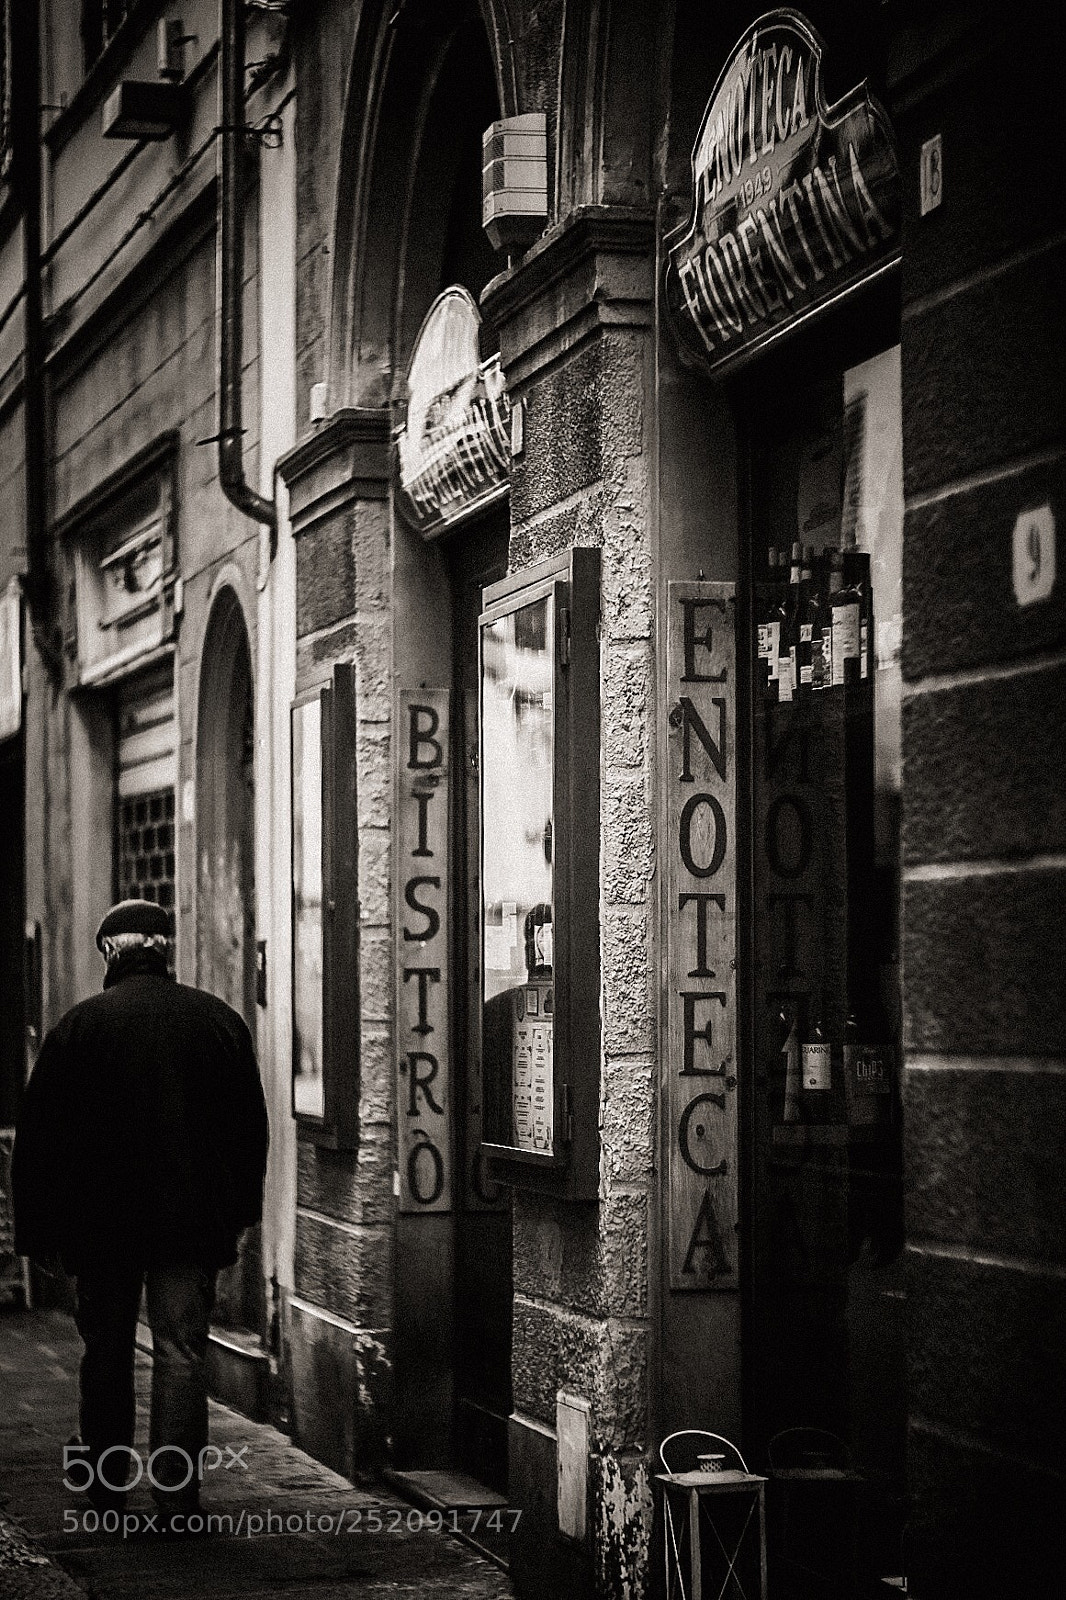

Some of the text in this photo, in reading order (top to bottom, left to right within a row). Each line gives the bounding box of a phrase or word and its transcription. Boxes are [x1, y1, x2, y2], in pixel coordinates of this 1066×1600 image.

[701, 36, 811, 205] ENOTECA
[738, 165, 774, 208] 1949
[677, 141, 896, 352] FIORENTINA
[678, 598, 733, 1274] ENOTECA
